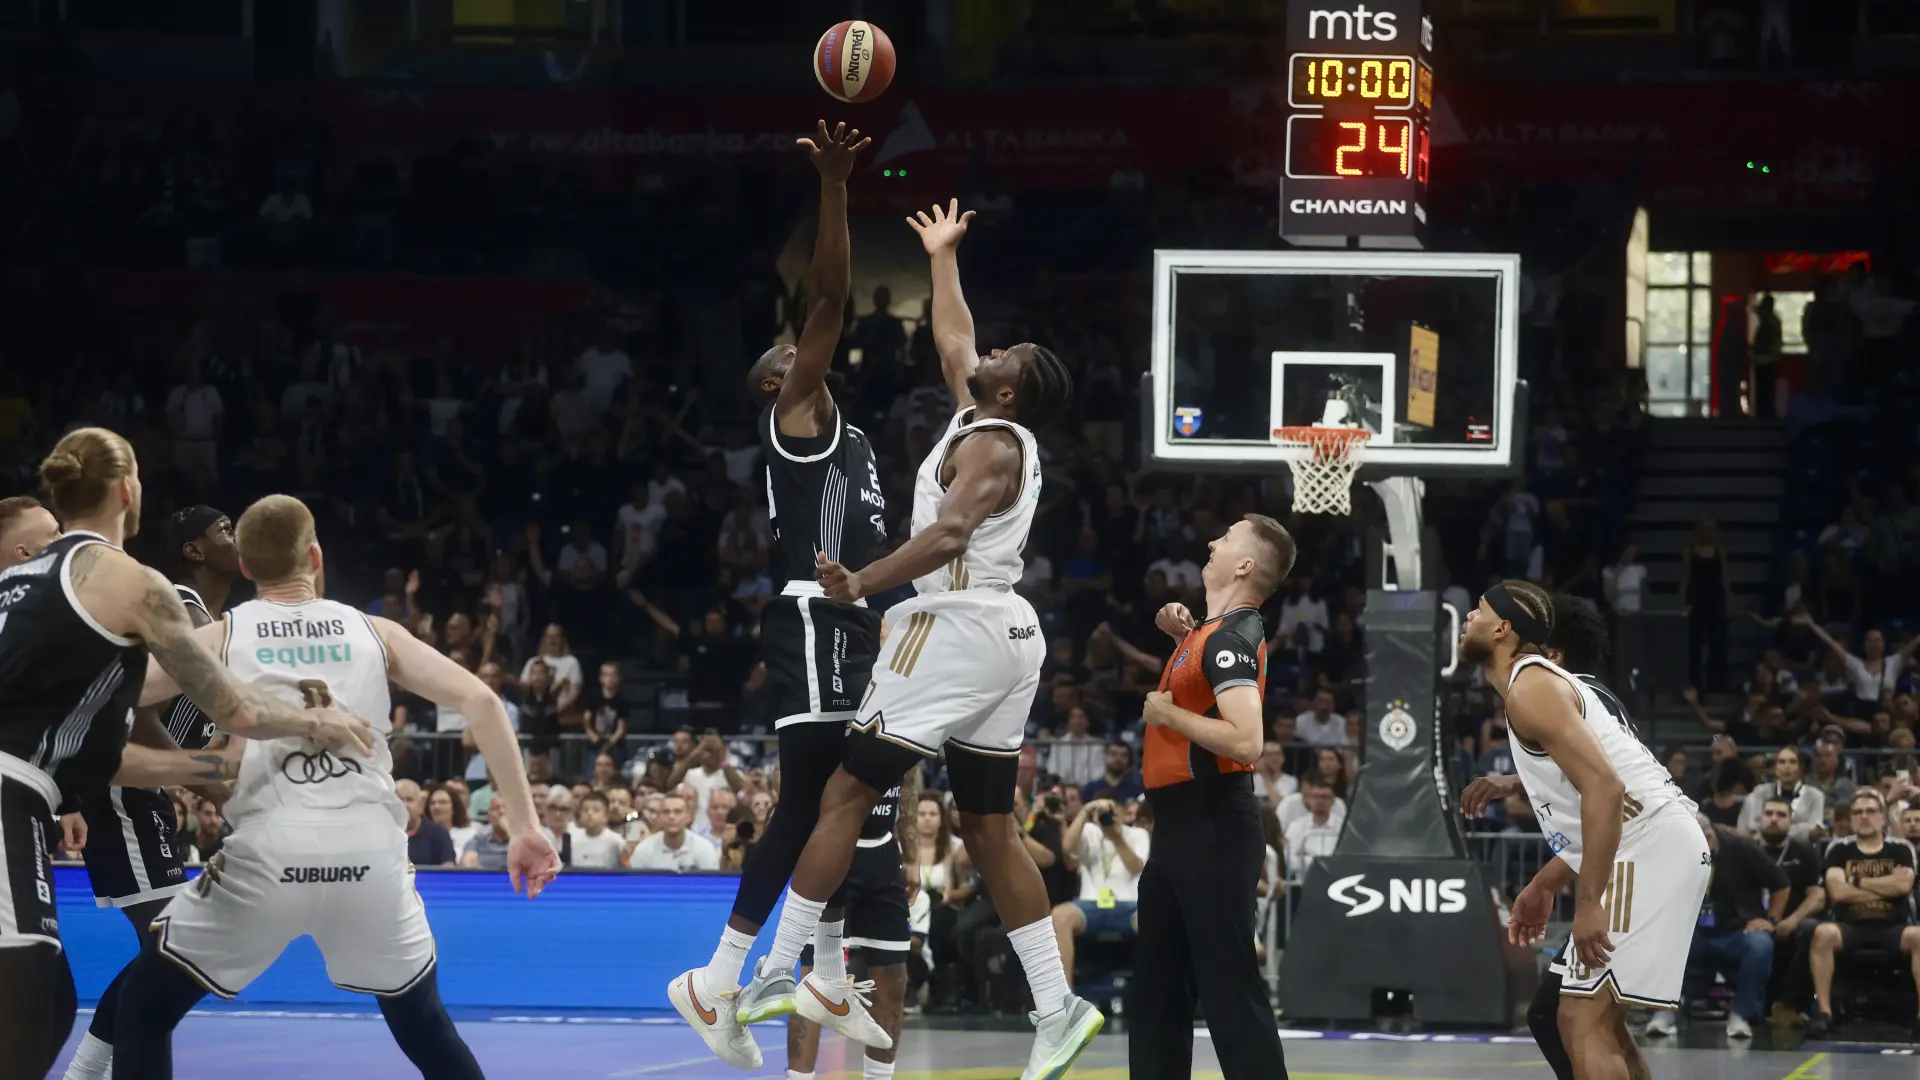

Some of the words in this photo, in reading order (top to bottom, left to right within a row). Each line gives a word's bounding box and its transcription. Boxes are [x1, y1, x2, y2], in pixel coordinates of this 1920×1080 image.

[1308, 4, 1398, 41] mts
[846, 29, 865, 82] SPALDING
[1308, 60, 1410, 98] 10:00
[1336, 122, 1408, 175] 24
[1290, 199, 1406, 214] CHANGAN
[256, 619, 345, 639] BERTANS
[256, 643, 352, 668] equiti
[872, 804, 892, 816] NIS
[166, 867, 183, 877] mts
[280, 865, 371, 883] SUBWAY
[1389, 878, 1468, 914] NIS
